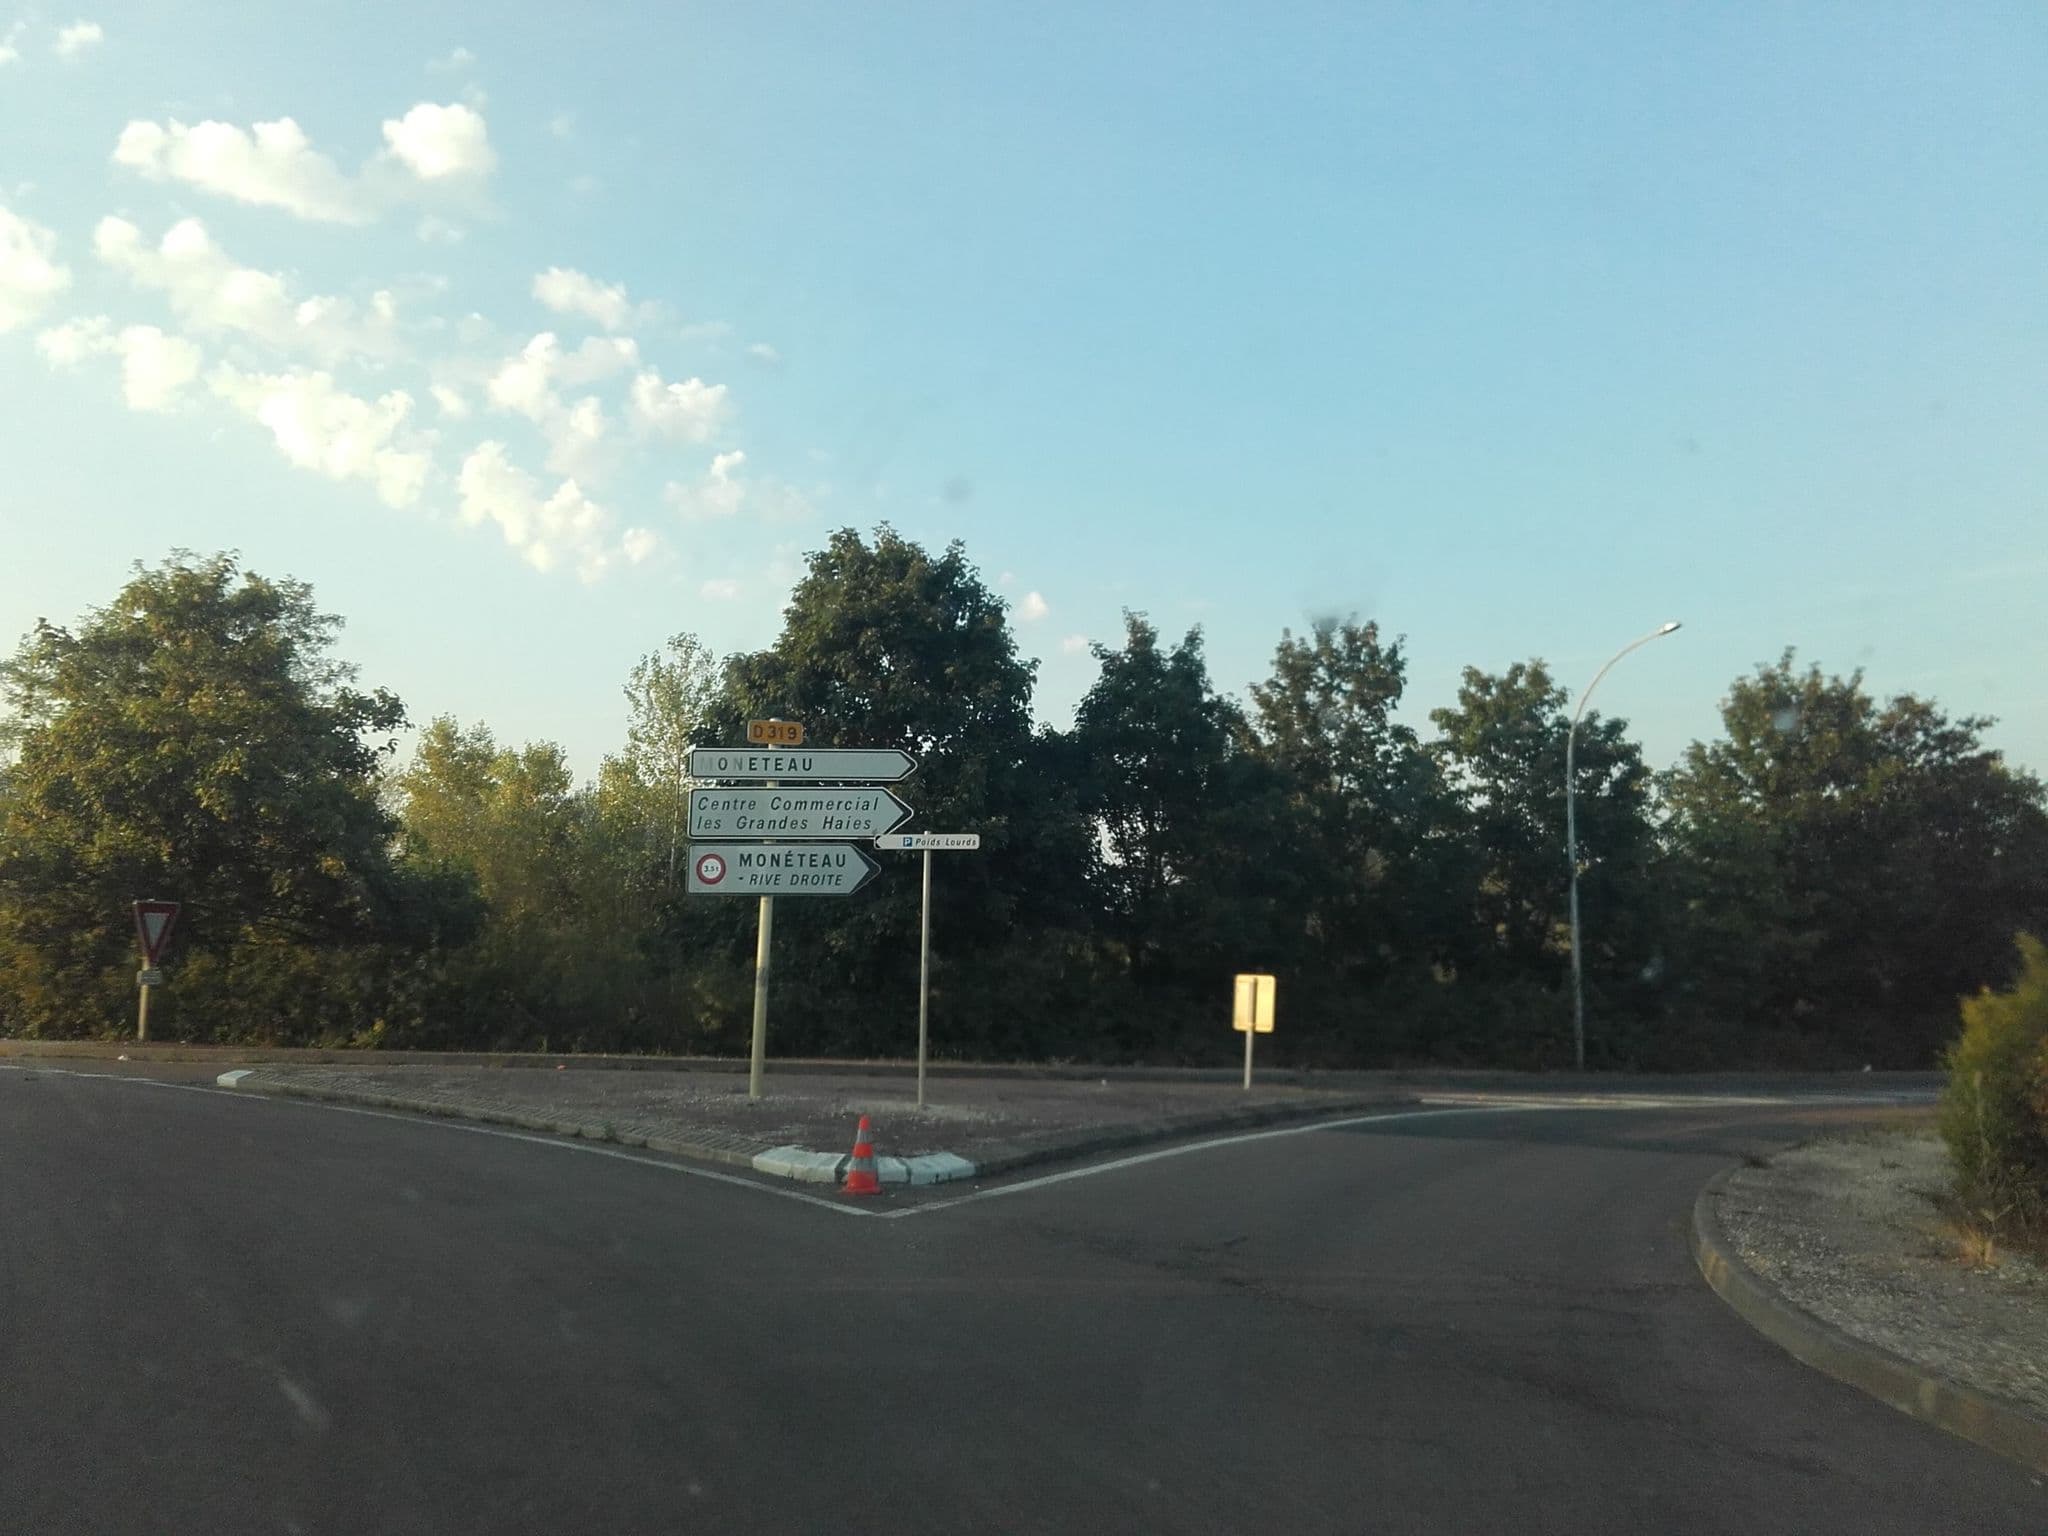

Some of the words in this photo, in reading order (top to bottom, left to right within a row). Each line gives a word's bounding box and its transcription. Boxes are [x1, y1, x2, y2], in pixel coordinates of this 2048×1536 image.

[697, 797, 757, 811] Centre
[770, 797, 879, 811] Commercial
[697, 817, 721, 830] les
[736, 816, 808, 830] Grandes
[822, 816, 871, 830] Haies
[739, 851, 846, 868] MONÉTEAU
[750, 874, 781, 886] RIVE
[790, 874, 843, 886] DROITE
